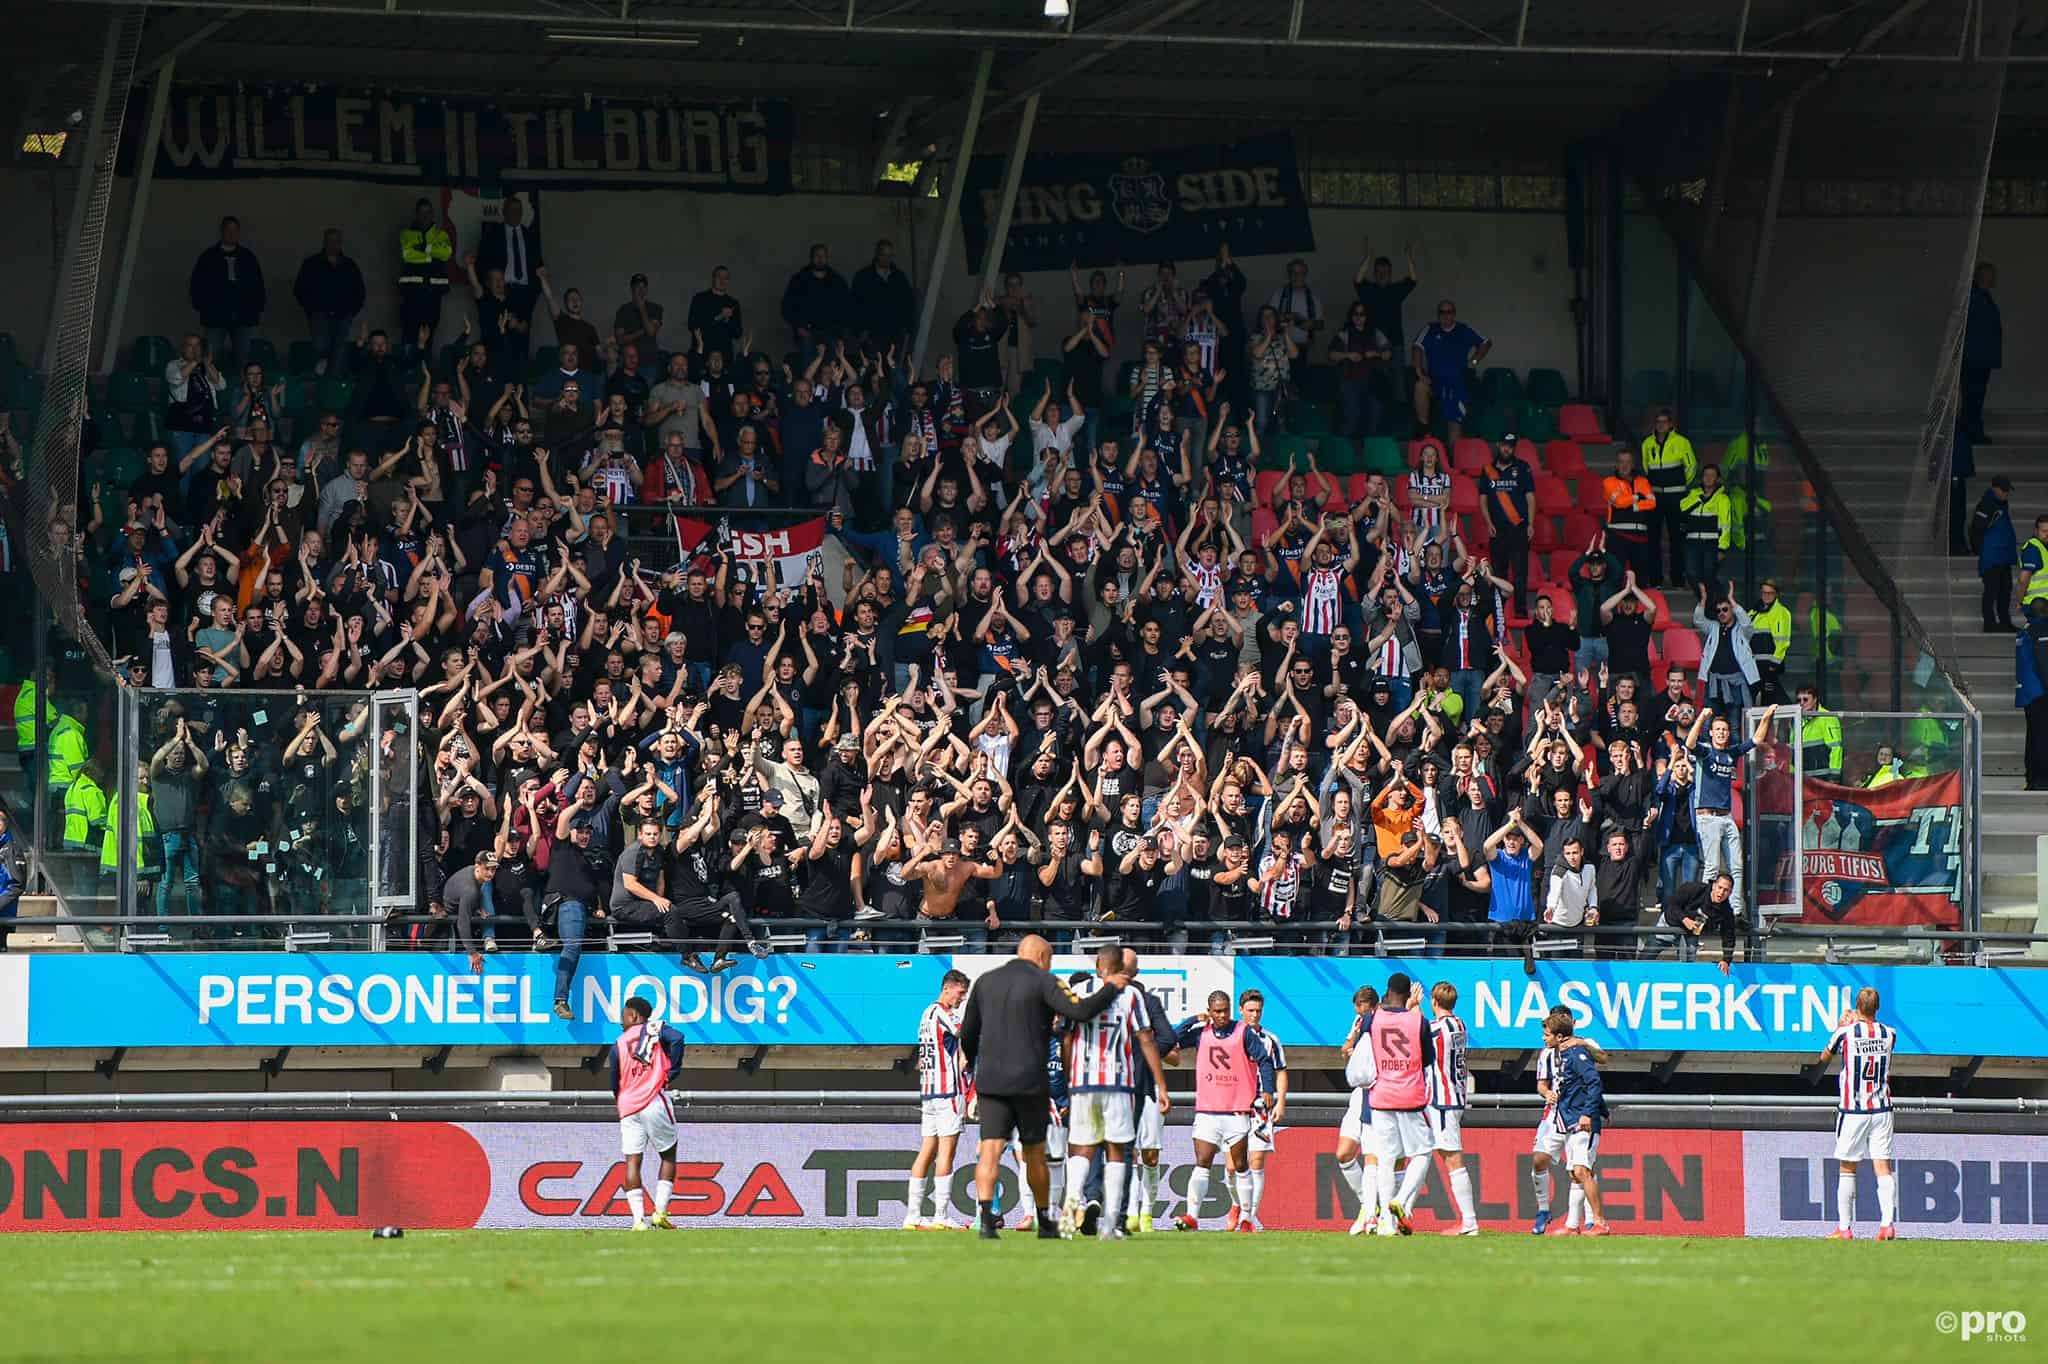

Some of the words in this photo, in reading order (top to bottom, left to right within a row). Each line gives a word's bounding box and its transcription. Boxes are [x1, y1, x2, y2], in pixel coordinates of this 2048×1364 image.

[160, 93, 417, 169] WILLEM
[444, 108, 479, 178] II
[503, 106, 769, 185] TILBURG
[1176, 167, 1285, 213] SIDE
[1778, 855, 1836, 876] TIBURG
[1839, 855, 1886, 880] TIFOSI
[199, 973, 550, 1026] PERSONEEL
[583, 973, 798, 1025] NODIG?
[1381, 1060, 1412, 1072] ROBEY
[1861, 1060, 1881, 1087] 4
[0, 1146, 360, 1220] NICS.N
